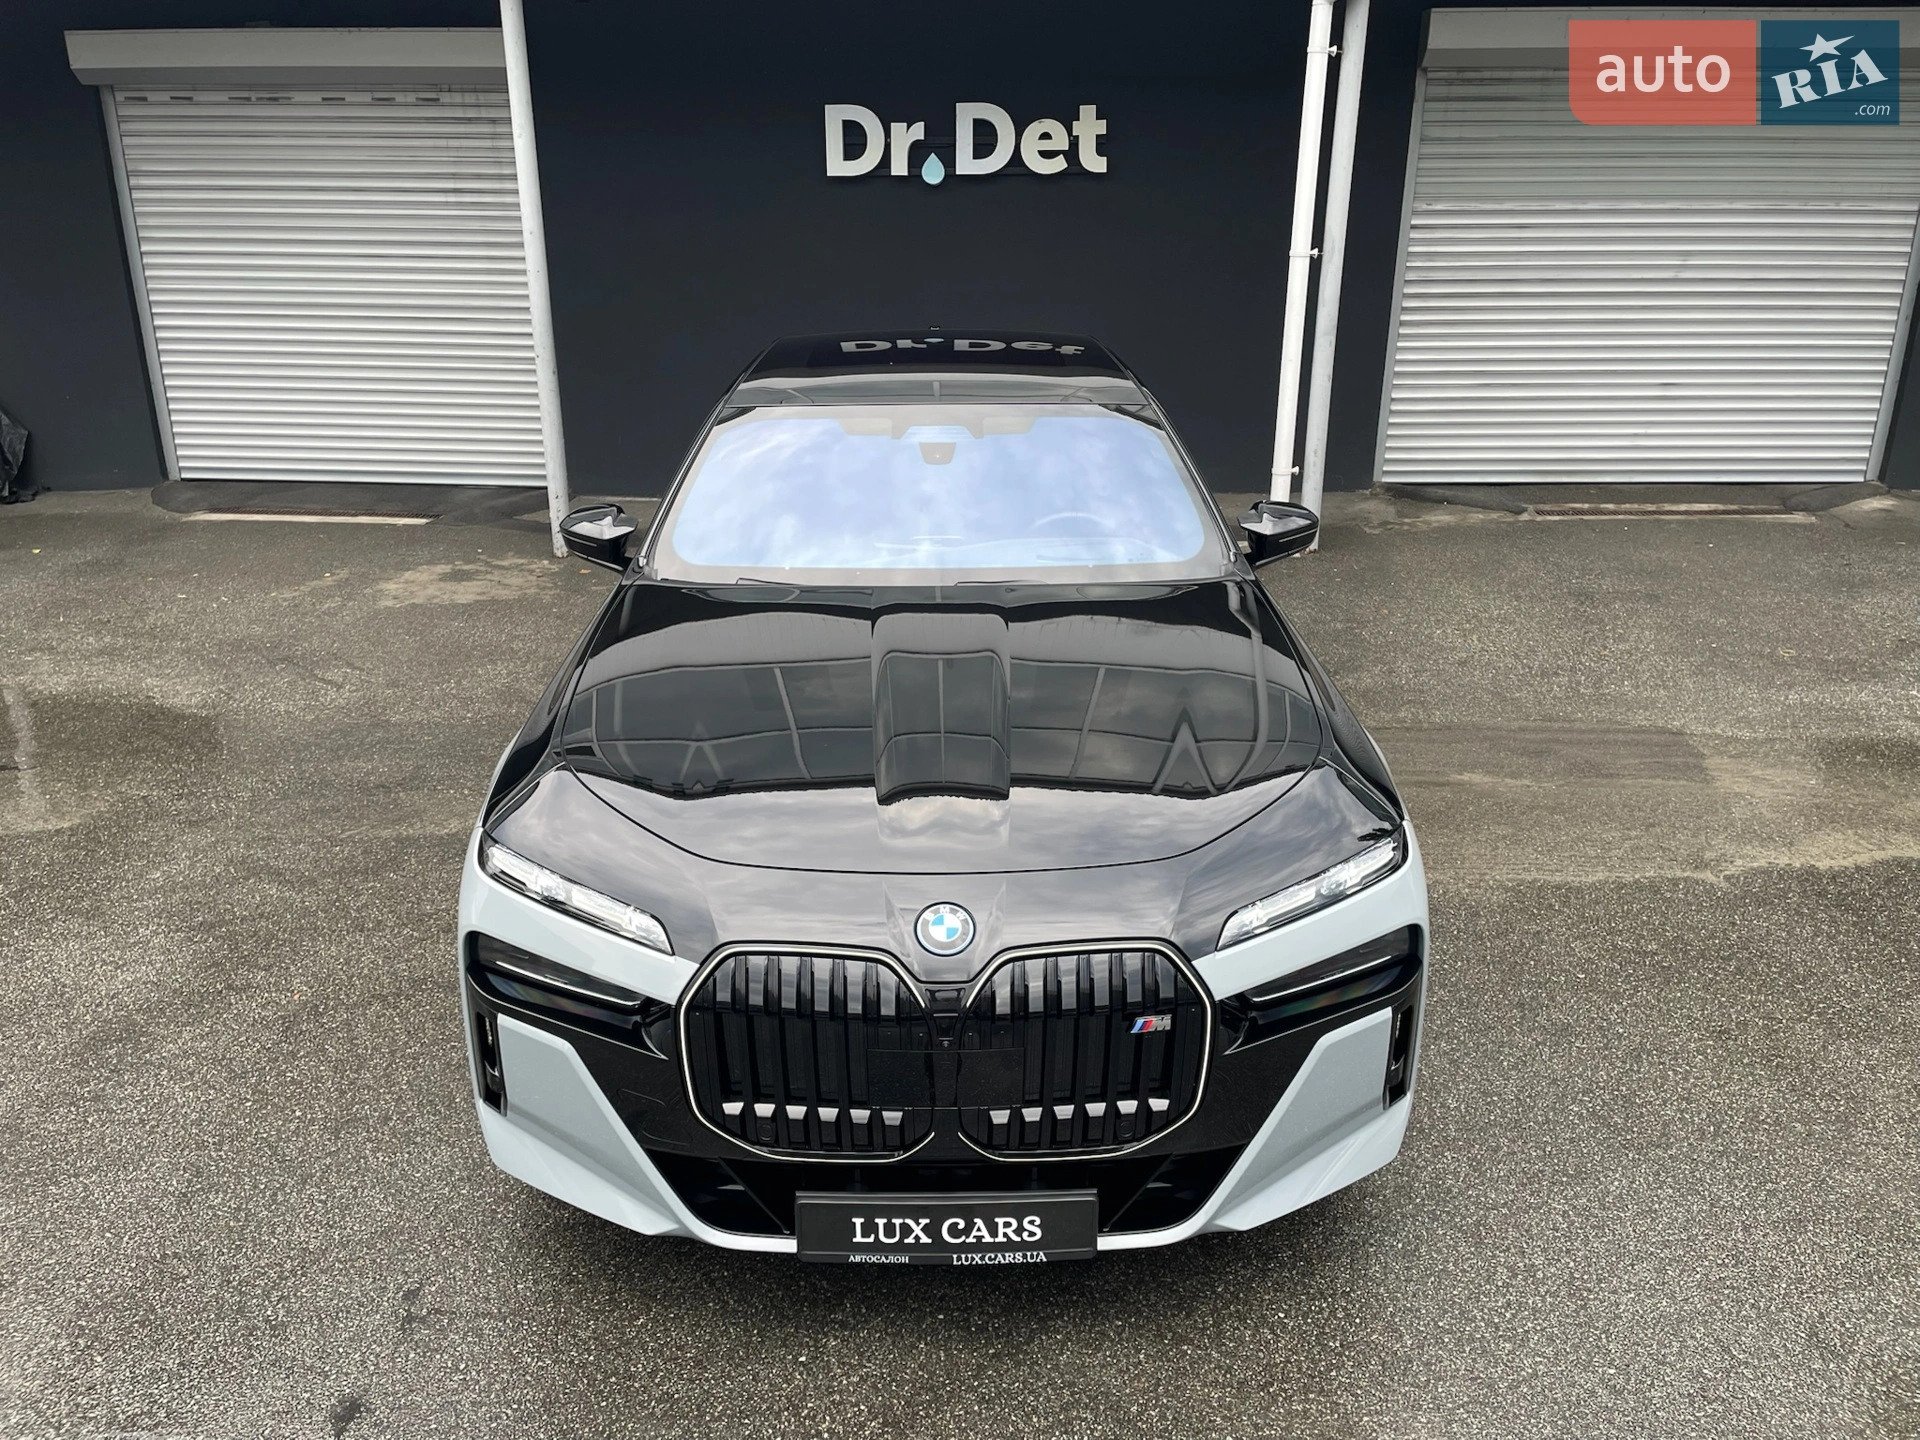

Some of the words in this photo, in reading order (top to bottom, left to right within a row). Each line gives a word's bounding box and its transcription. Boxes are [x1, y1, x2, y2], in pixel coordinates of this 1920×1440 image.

[851, 1217, 932, 1244] LUX
[941, 1215, 1042, 1243] CARS
[848, 1254, 909, 1264] АВТОСАЛОН
[952, 1251, 1047, 1266] LUX.CARS.UA
